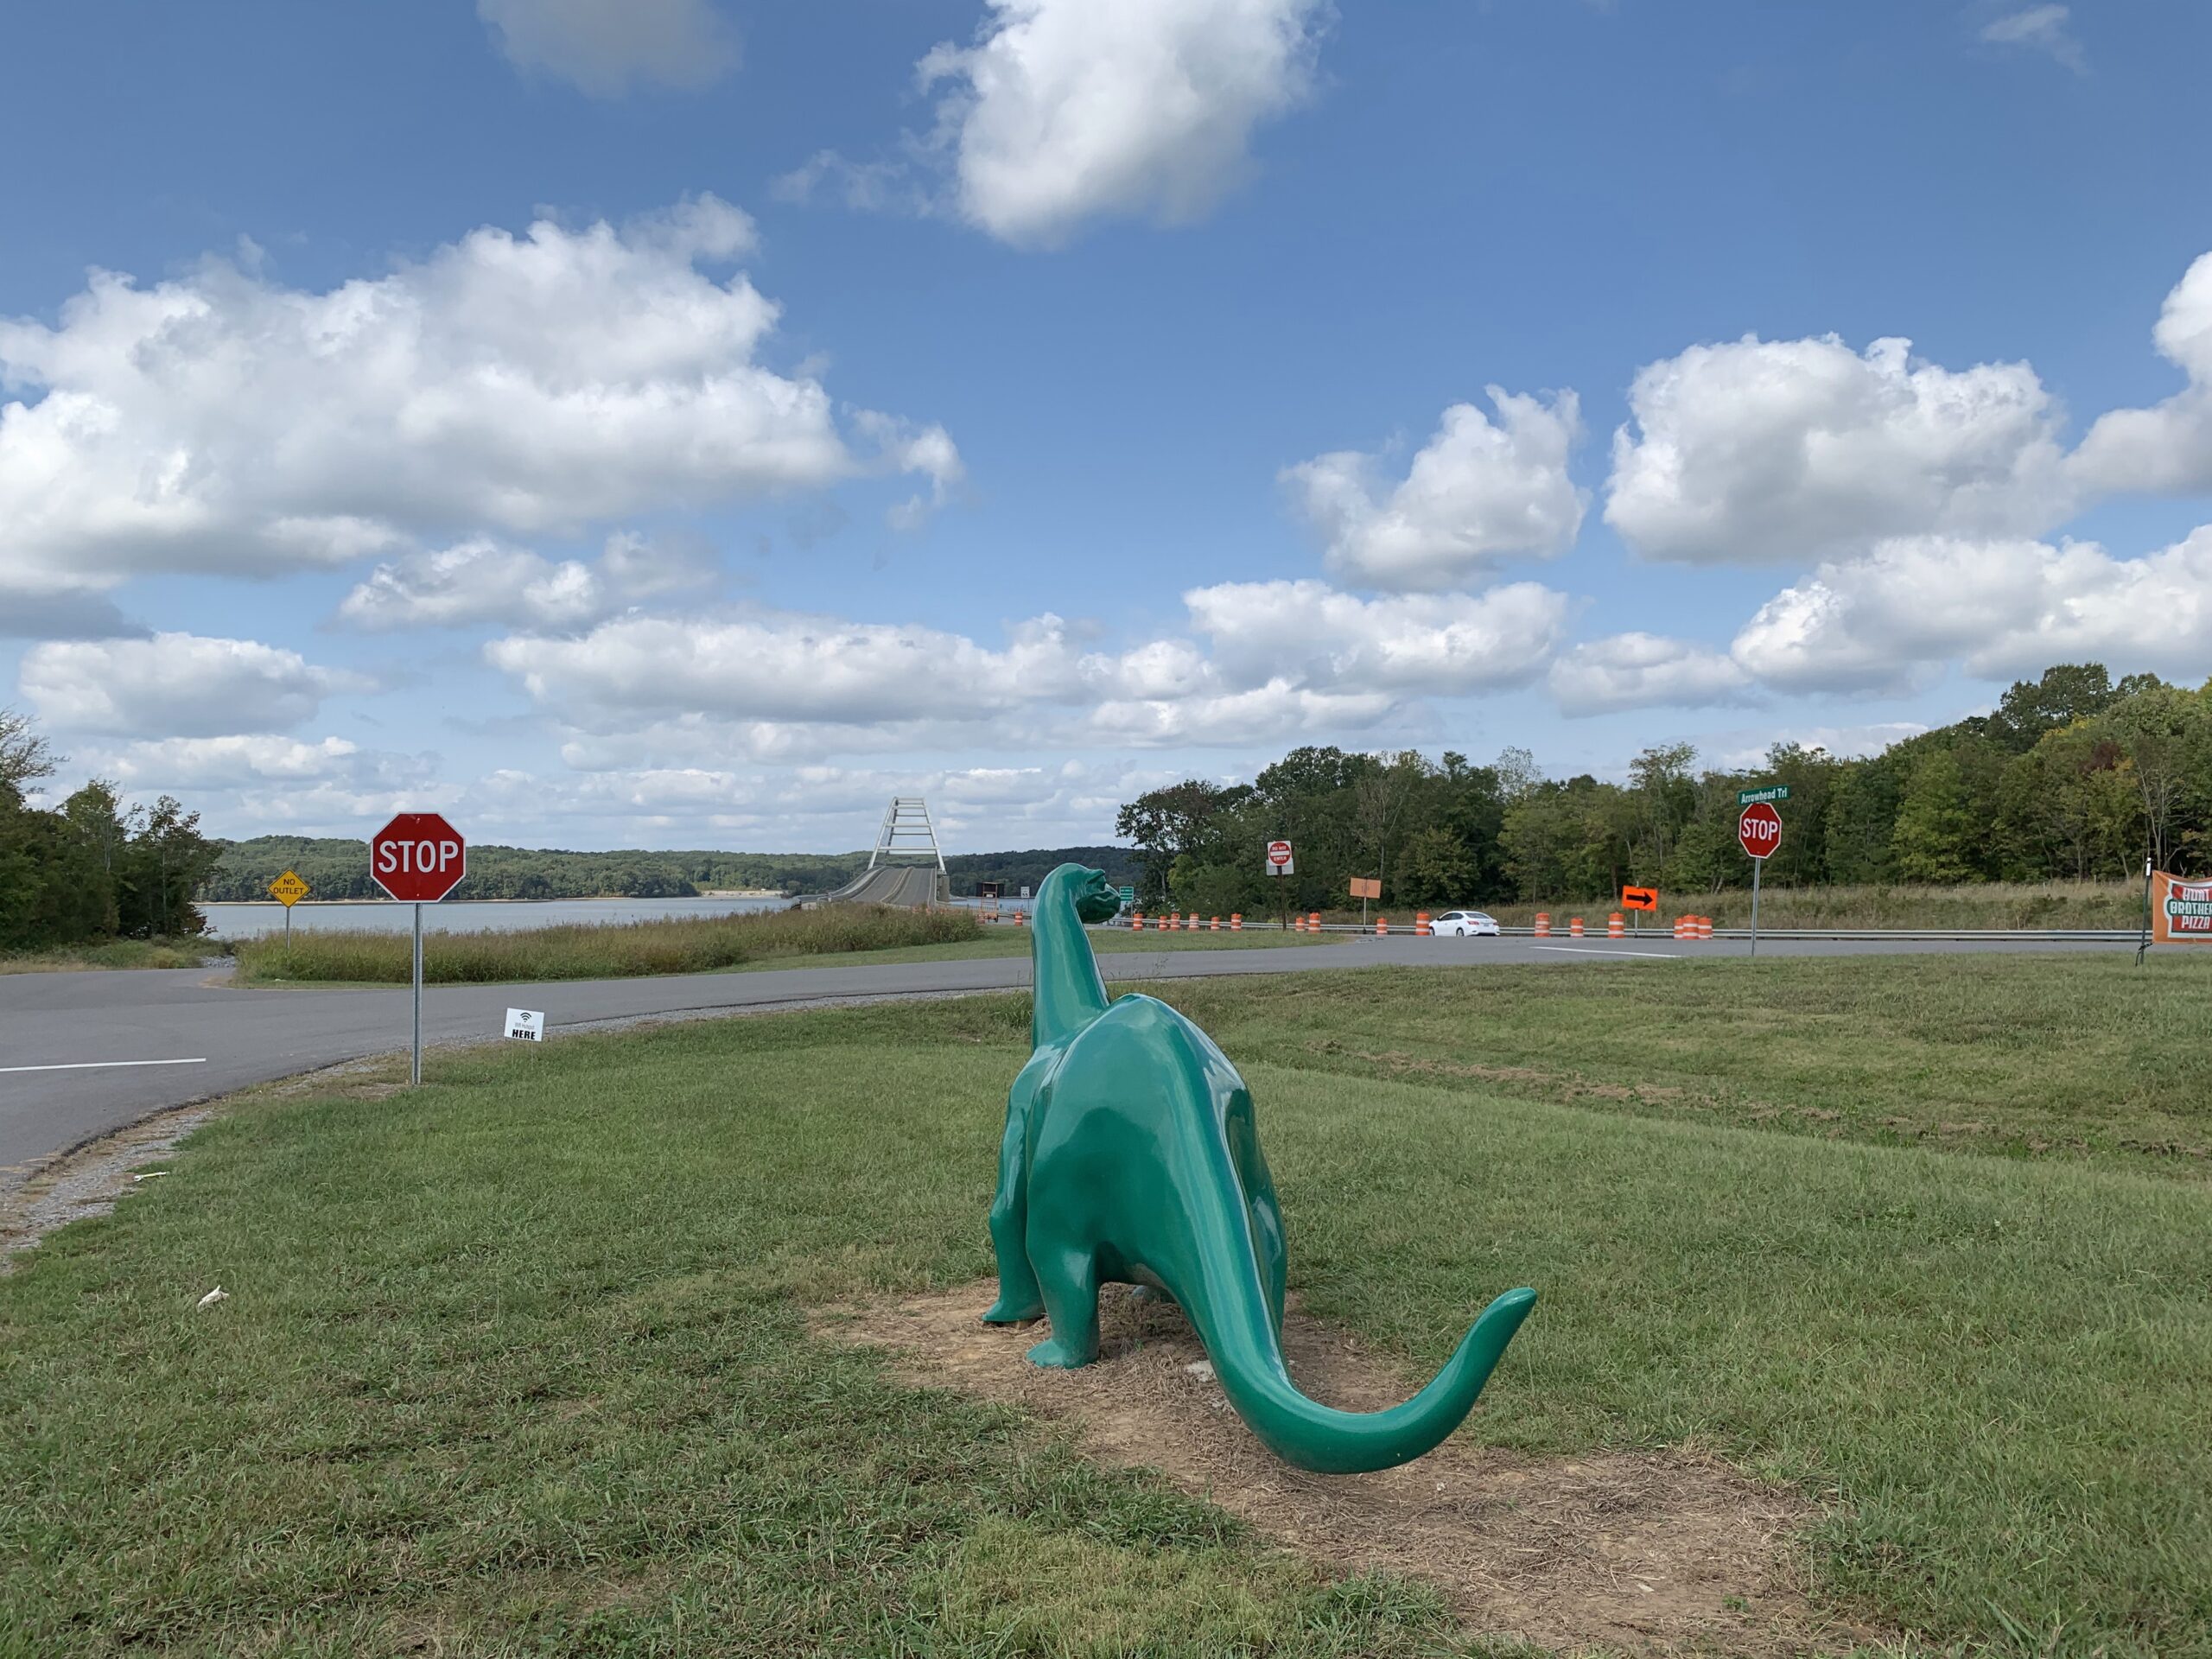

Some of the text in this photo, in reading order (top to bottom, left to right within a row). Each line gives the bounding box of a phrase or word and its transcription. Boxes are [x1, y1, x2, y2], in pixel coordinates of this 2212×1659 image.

[1740, 787, 1788, 804] Arrowhead Trl
[1742, 817, 1778, 842] STOP
[378, 840, 459, 874] STOP
[273, 887, 304, 895] OUTLET
[2182, 887, 2210, 902] HUNT
[2181, 915, 2211, 930] PIZZA
[512, 1028, 536, 1040] HERE
